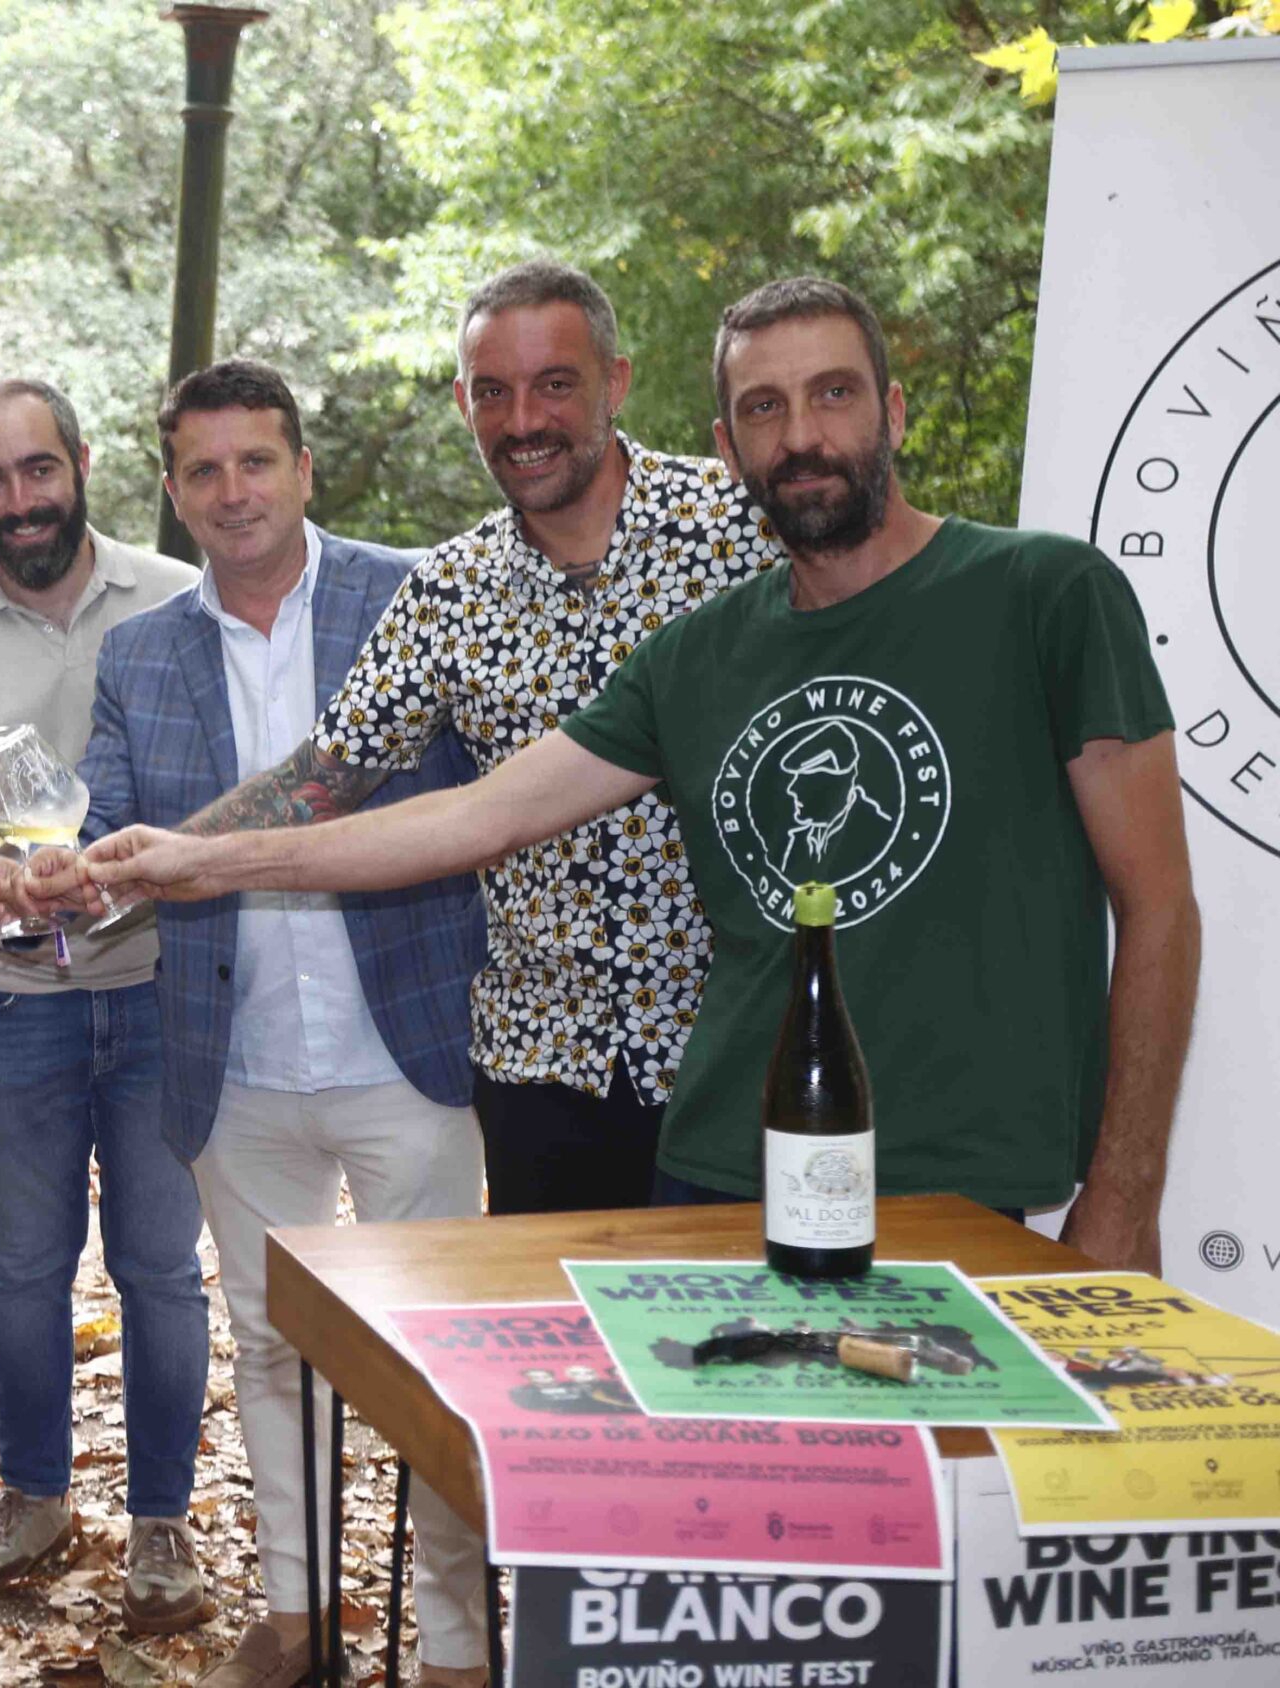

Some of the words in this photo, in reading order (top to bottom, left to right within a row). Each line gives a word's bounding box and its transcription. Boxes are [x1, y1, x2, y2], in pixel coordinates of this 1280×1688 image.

[806, 687, 887, 717] WINE
[897, 720, 940, 807] FEST
[835, 862, 903, 918] 2024
[784, 1204, 813, 1221] VAL
[819, 1208, 844, 1221] DO
[595, 1286, 776, 1301] WINE
[795, 1286, 953, 1302] FEST
[1040, 1296, 1197, 1318] FEST
[796, 1429, 903, 1448] BOIRO
[984, 1563, 1170, 1630] WINE
[1196, 1552, 1280, 1614] FE
[569, 1581, 883, 1646] BLANCO
[1081, 1639, 1125, 1657] VIÑO
[1133, 1628, 1259, 1654] GASTRONOMÍA
[577, 1659, 703, 1688] BOVIÑO
[713, 1664, 793, 1688] WINE
[801, 1660, 874, 1687] FEST
[1031, 1655, 1095, 1674] MÚSICA
[1105, 1649, 1213, 1669] PATRIMONIO
